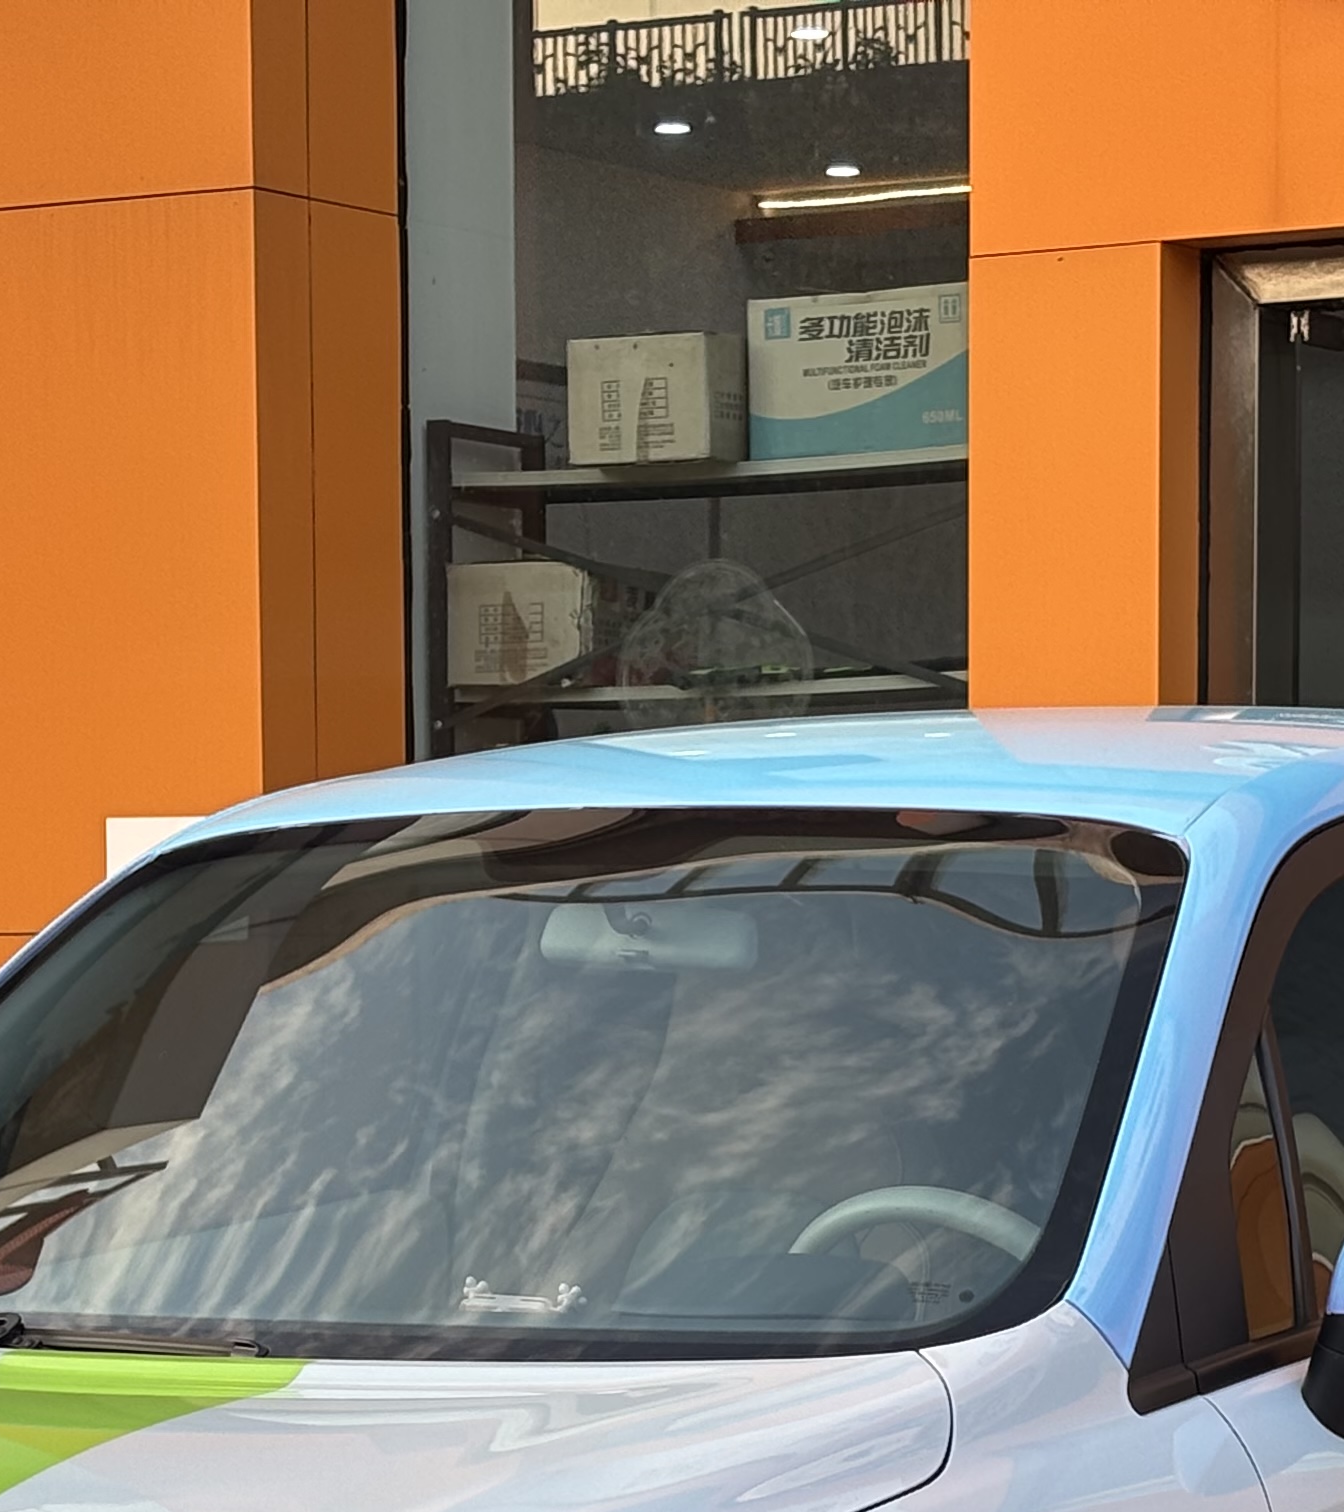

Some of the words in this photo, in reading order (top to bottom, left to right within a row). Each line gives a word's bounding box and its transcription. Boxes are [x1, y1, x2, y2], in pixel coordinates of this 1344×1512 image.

[798, 308, 931, 341] 多功能泡沫
[845, 333, 931, 363] 清洁剂
